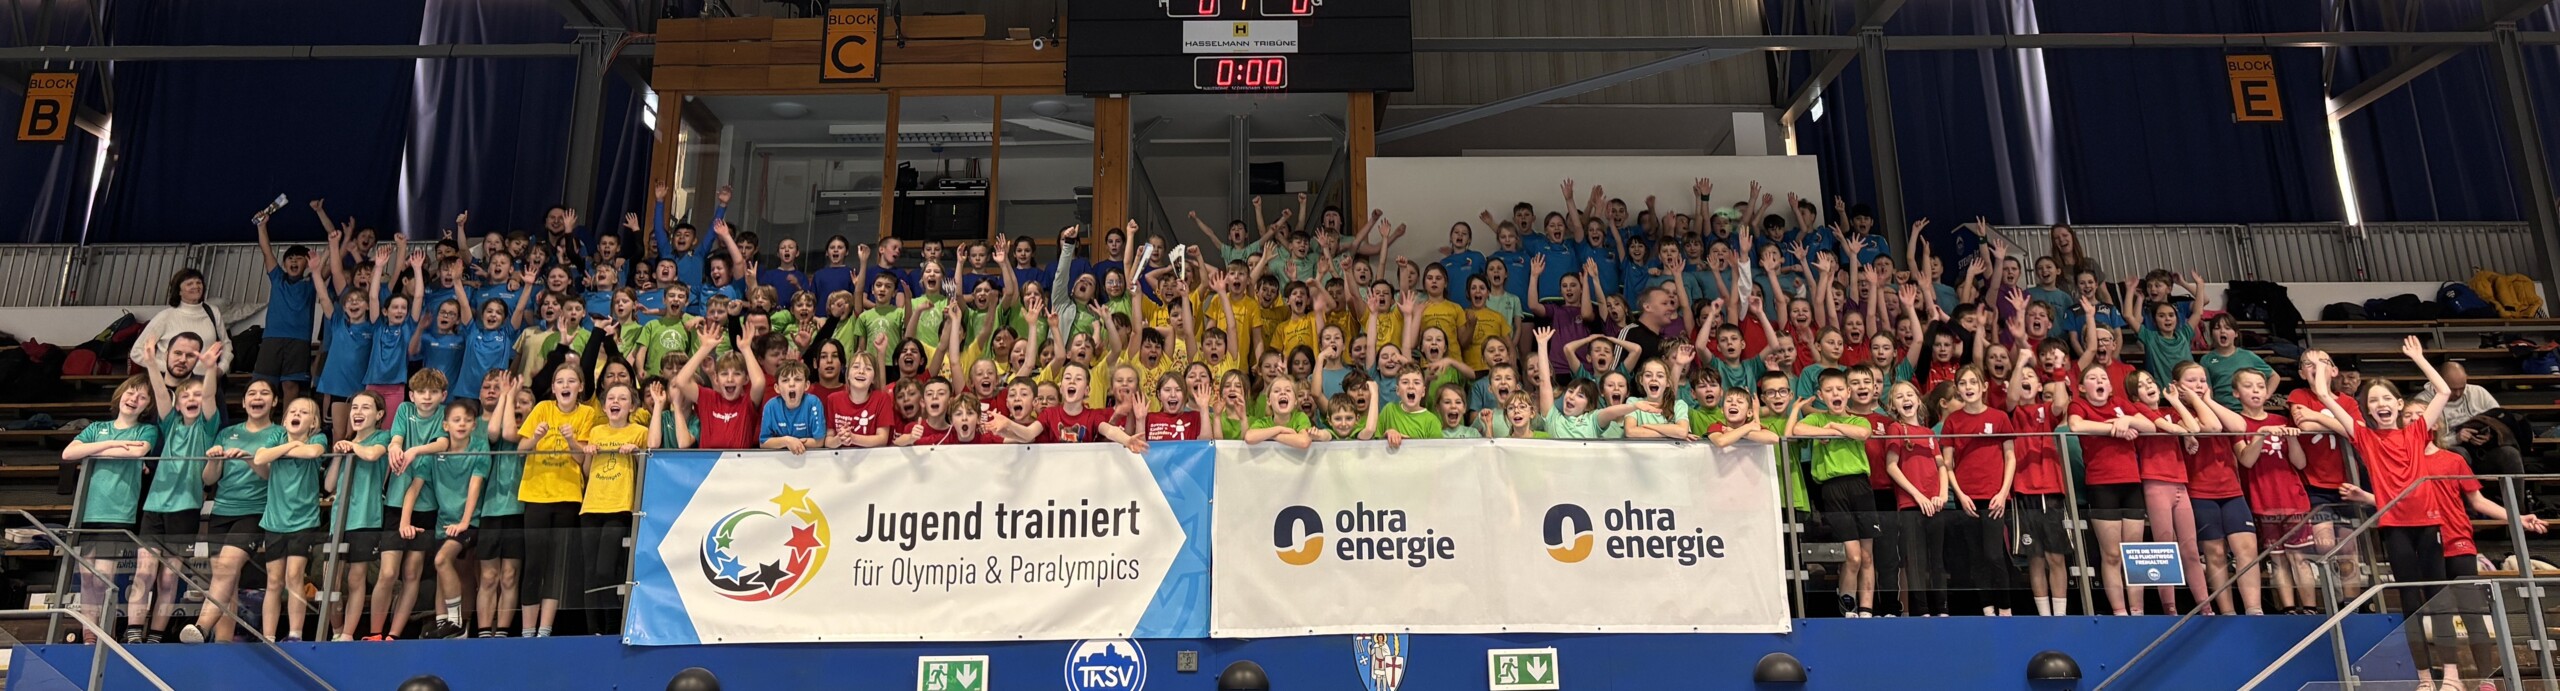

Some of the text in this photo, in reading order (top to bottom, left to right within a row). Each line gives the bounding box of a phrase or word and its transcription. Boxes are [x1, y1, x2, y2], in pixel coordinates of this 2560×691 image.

[828, 14, 876, 25] BLOCK
[831, 35, 867, 73] C
[1253, 39, 1296, 47] TRIBÜNE
[1217, 59, 1283, 86] 0:00
[2228, 61, 2273, 71] BLOCK
[29, 79, 75, 89] BLOCK
[2240, 81, 2274, 117] E
[27, 99, 61, 136] B
[855, 499, 1140, 551] Jugend trainiert
[1336, 501, 1406, 532] ohra
[1604, 500, 1675, 531] ohra
[1336, 528, 1455, 568] energie
[1606, 527, 1725, 566] energie
[853, 553, 1140, 592] für Olympia & Paralympics
[1078, 665, 1134, 688] TKSV
